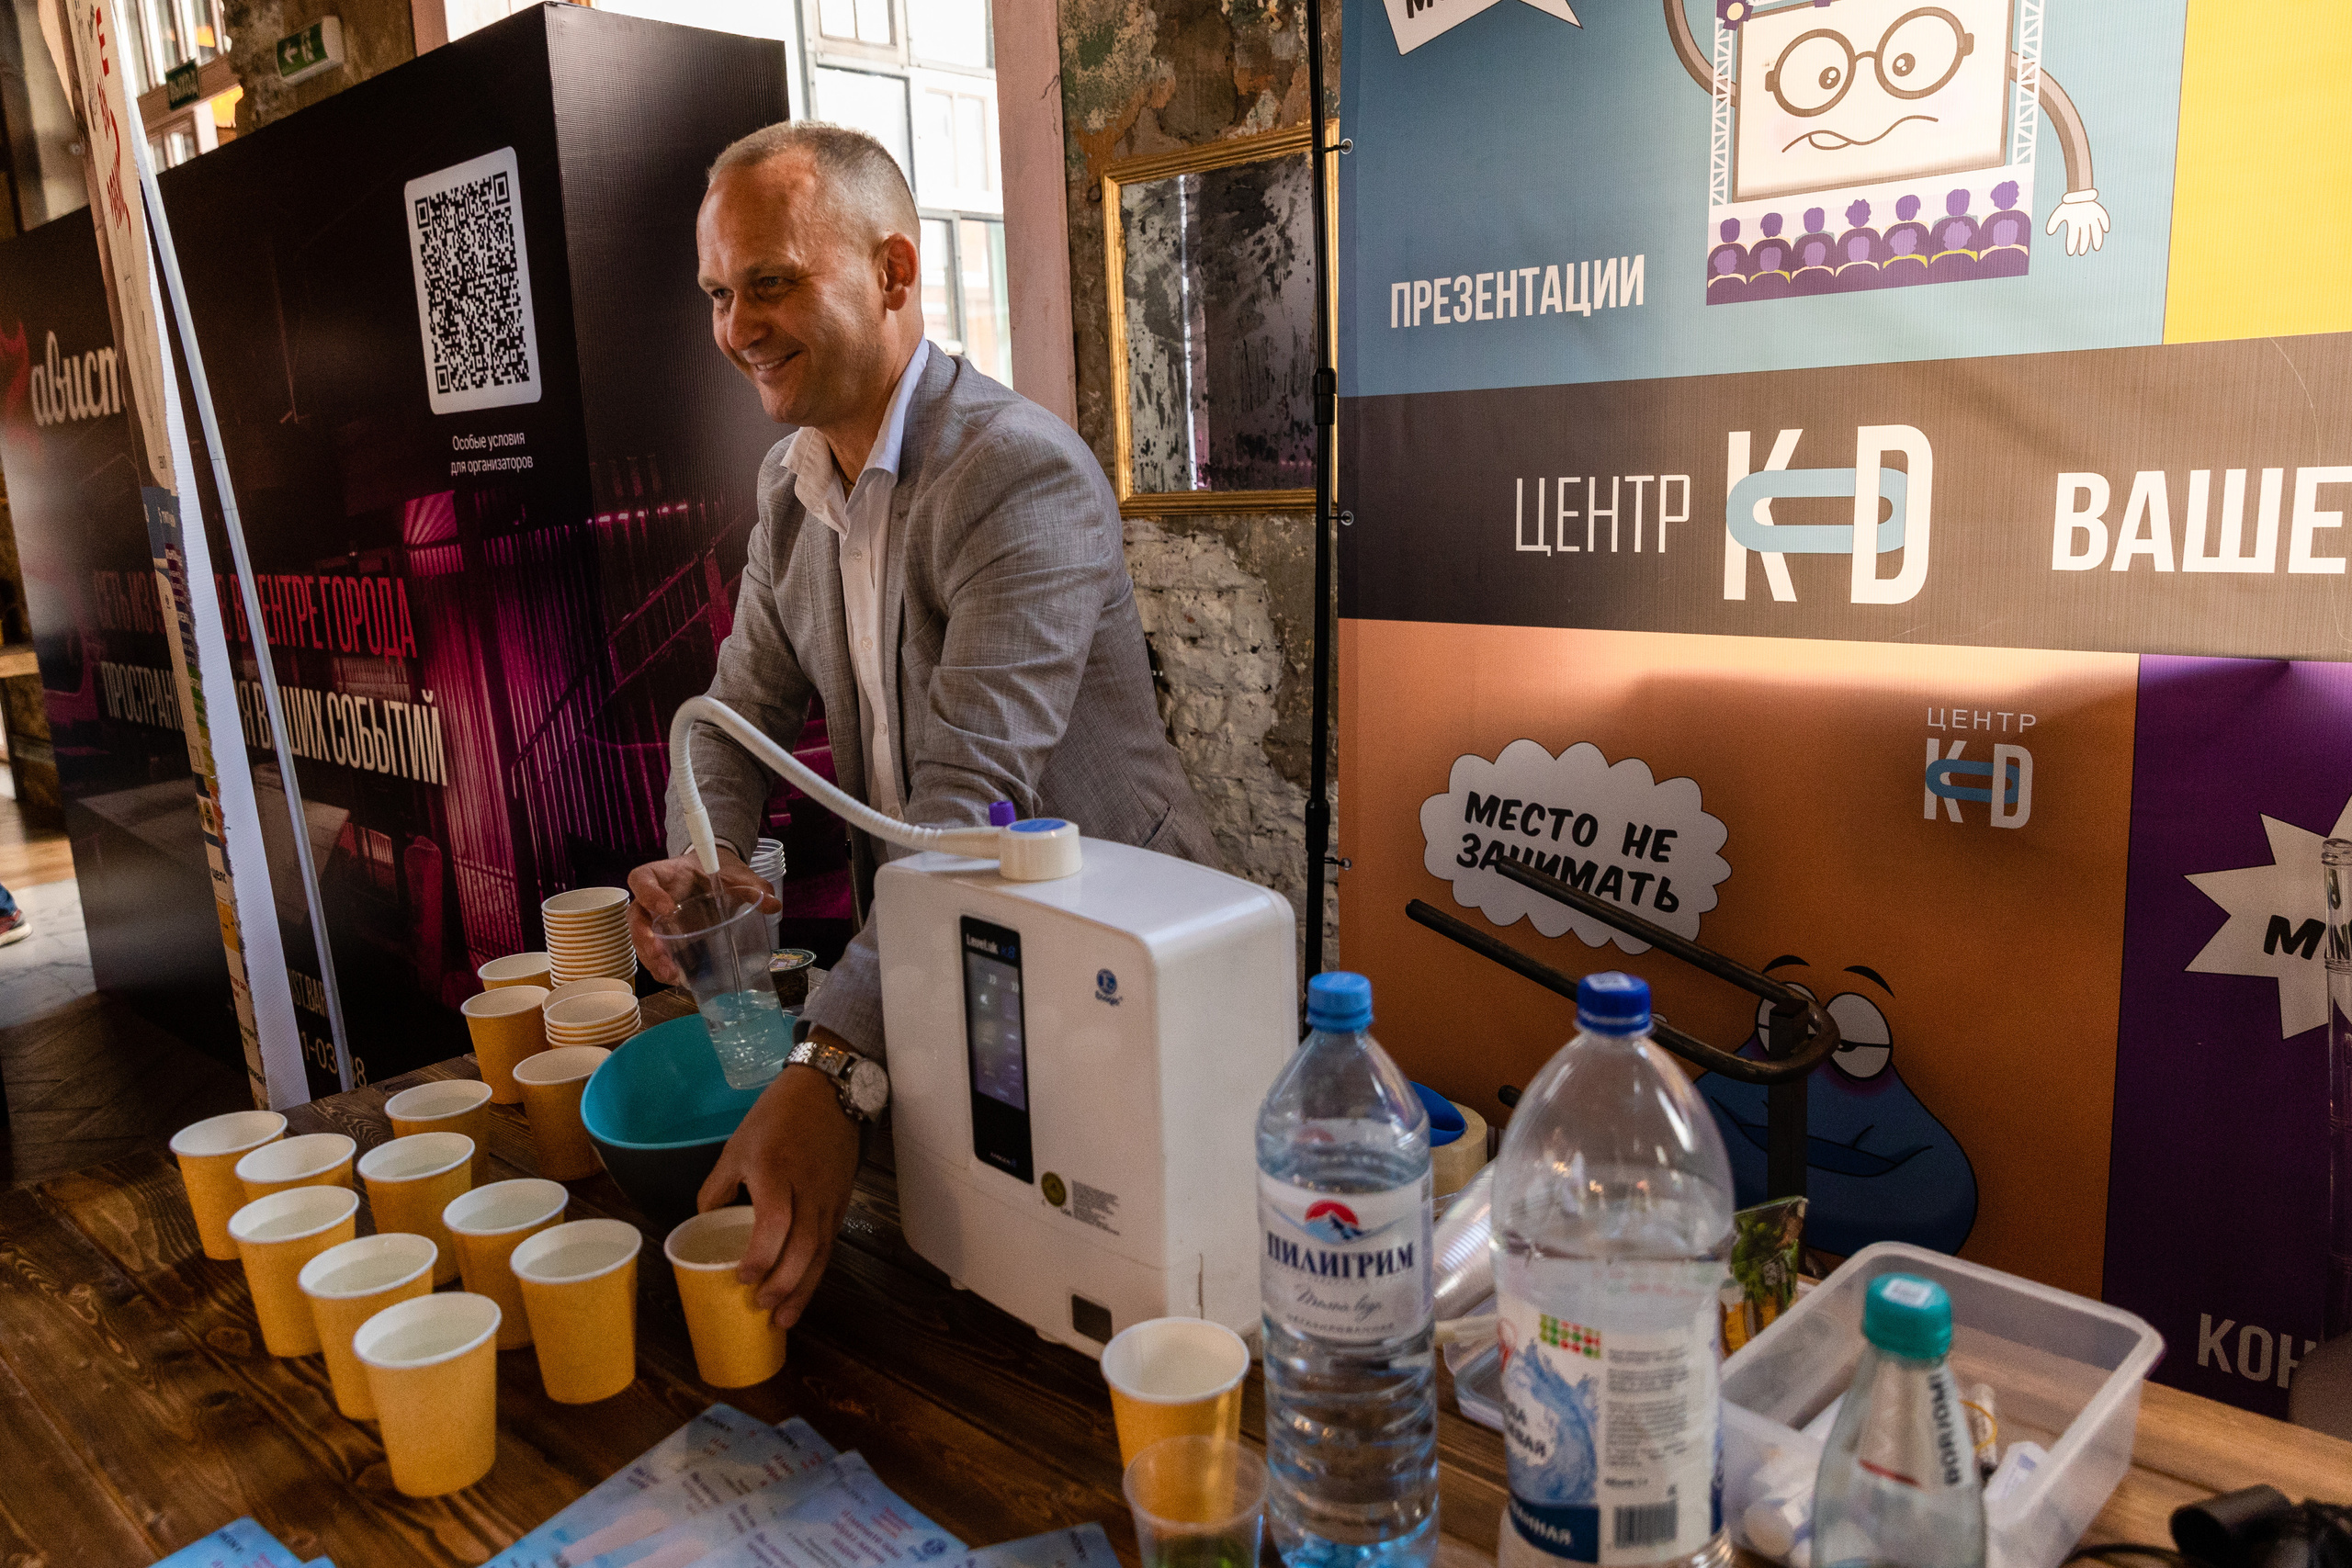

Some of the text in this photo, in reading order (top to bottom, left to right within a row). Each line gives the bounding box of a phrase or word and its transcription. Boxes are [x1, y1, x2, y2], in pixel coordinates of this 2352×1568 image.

[1390, 254, 1645, 329] ПРЕЗЕНТАЦИИ
[450, 456, 534, 477] для организаторов
[452, 432, 526, 452] Особые условия
[1515, 474, 1690, 557] ЦЕНТР
[2051, 465, 2352, 574] ВАШЕ
[253, 573, 323, 650] ЕНТРЕ
[320, 575, 418, 668] ГОРОДА
[100, 660, 185, 732] ПРОСТРАН
[252, 682, 332, 763] ВШИХ
[325, 689, 448, 787] СОБЫТИЙ
[1927, 706, 2038, 734] ЦЕНТР
[1464, 791, 1679, 863] МЕСТО НЕ
[1267, 1230, 1414, 1279] ПИЛИГРИМ
